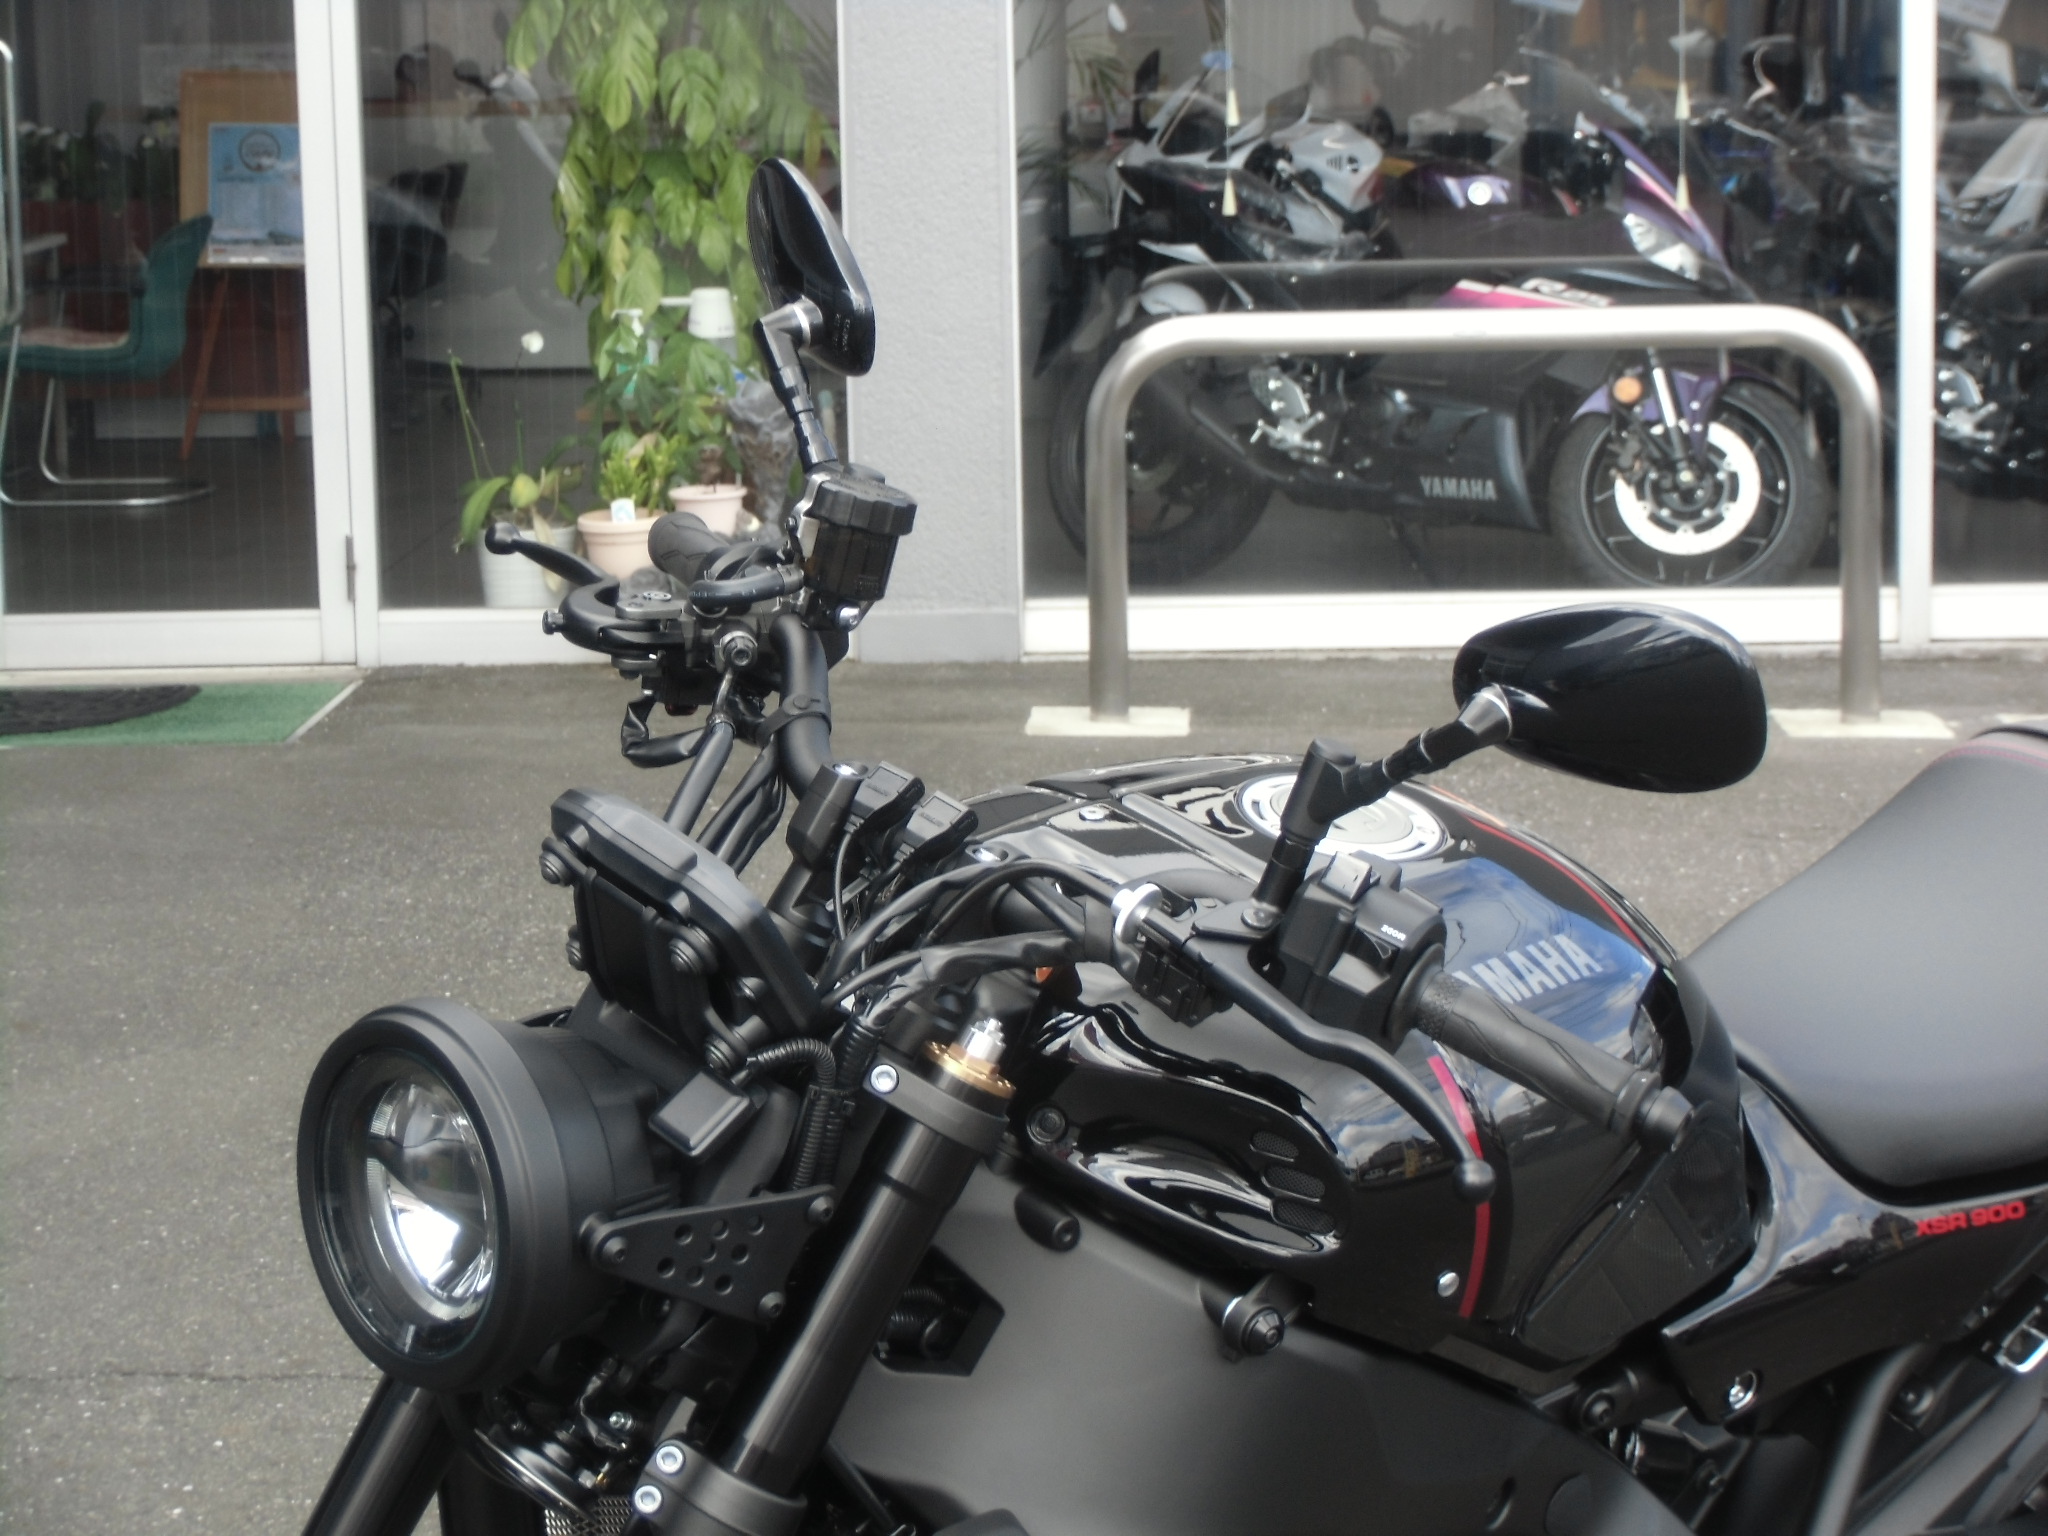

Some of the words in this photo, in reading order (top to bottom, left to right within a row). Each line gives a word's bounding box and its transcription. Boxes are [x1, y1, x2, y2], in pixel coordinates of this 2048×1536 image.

[1420, 476, 1497, 501] YAMAHA
[1916, 1211, 1968, 1237] XSR
[1970, 1201, 2027, 1227] 900
